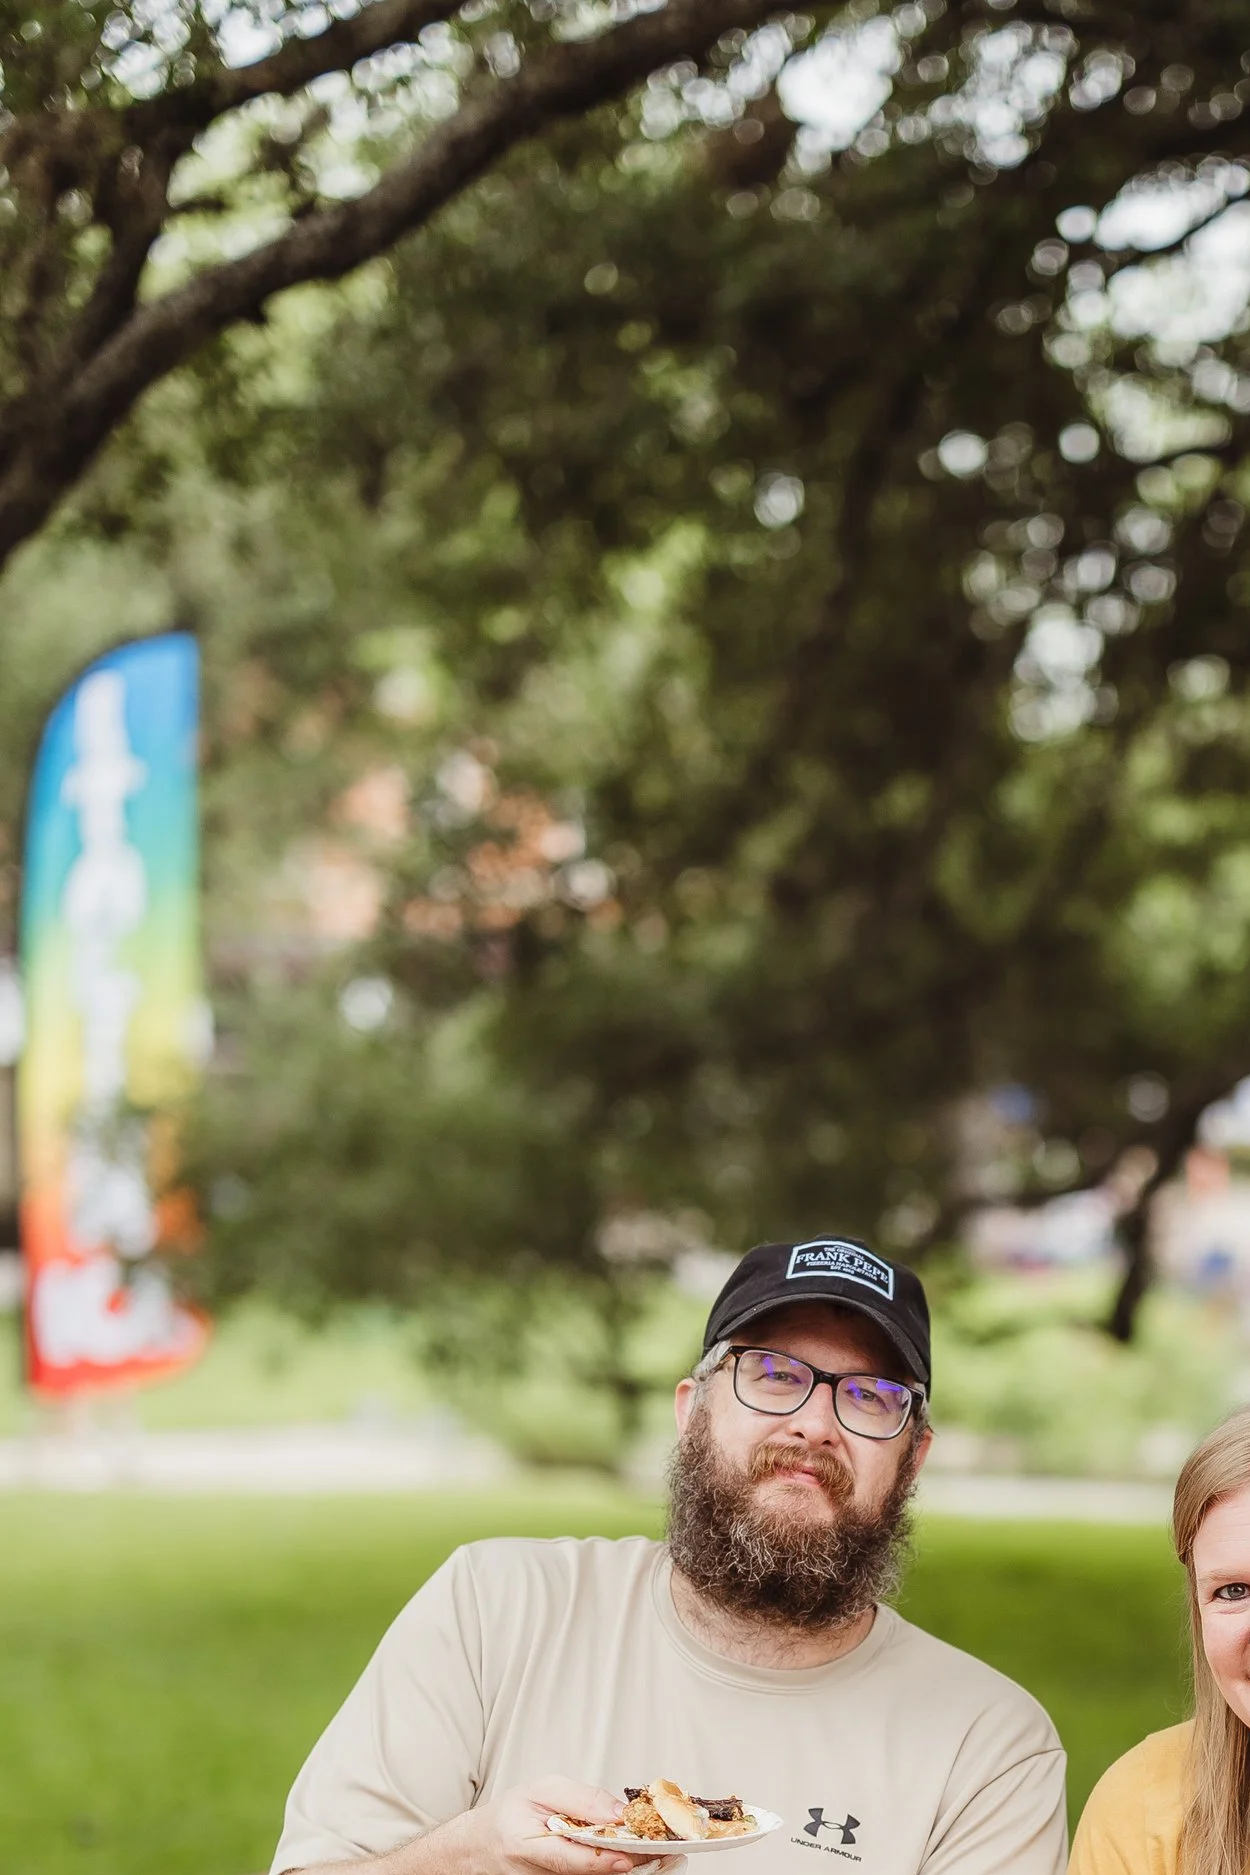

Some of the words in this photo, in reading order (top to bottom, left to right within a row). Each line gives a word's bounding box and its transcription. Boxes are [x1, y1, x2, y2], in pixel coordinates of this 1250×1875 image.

[795, 1252, 851, 1263] FRANK
[853, 1257, 889, 1284] PEPE
[790, 1837, 821, 1850] UNDER
[823, 1846, 862, 1862] ARMOUR
